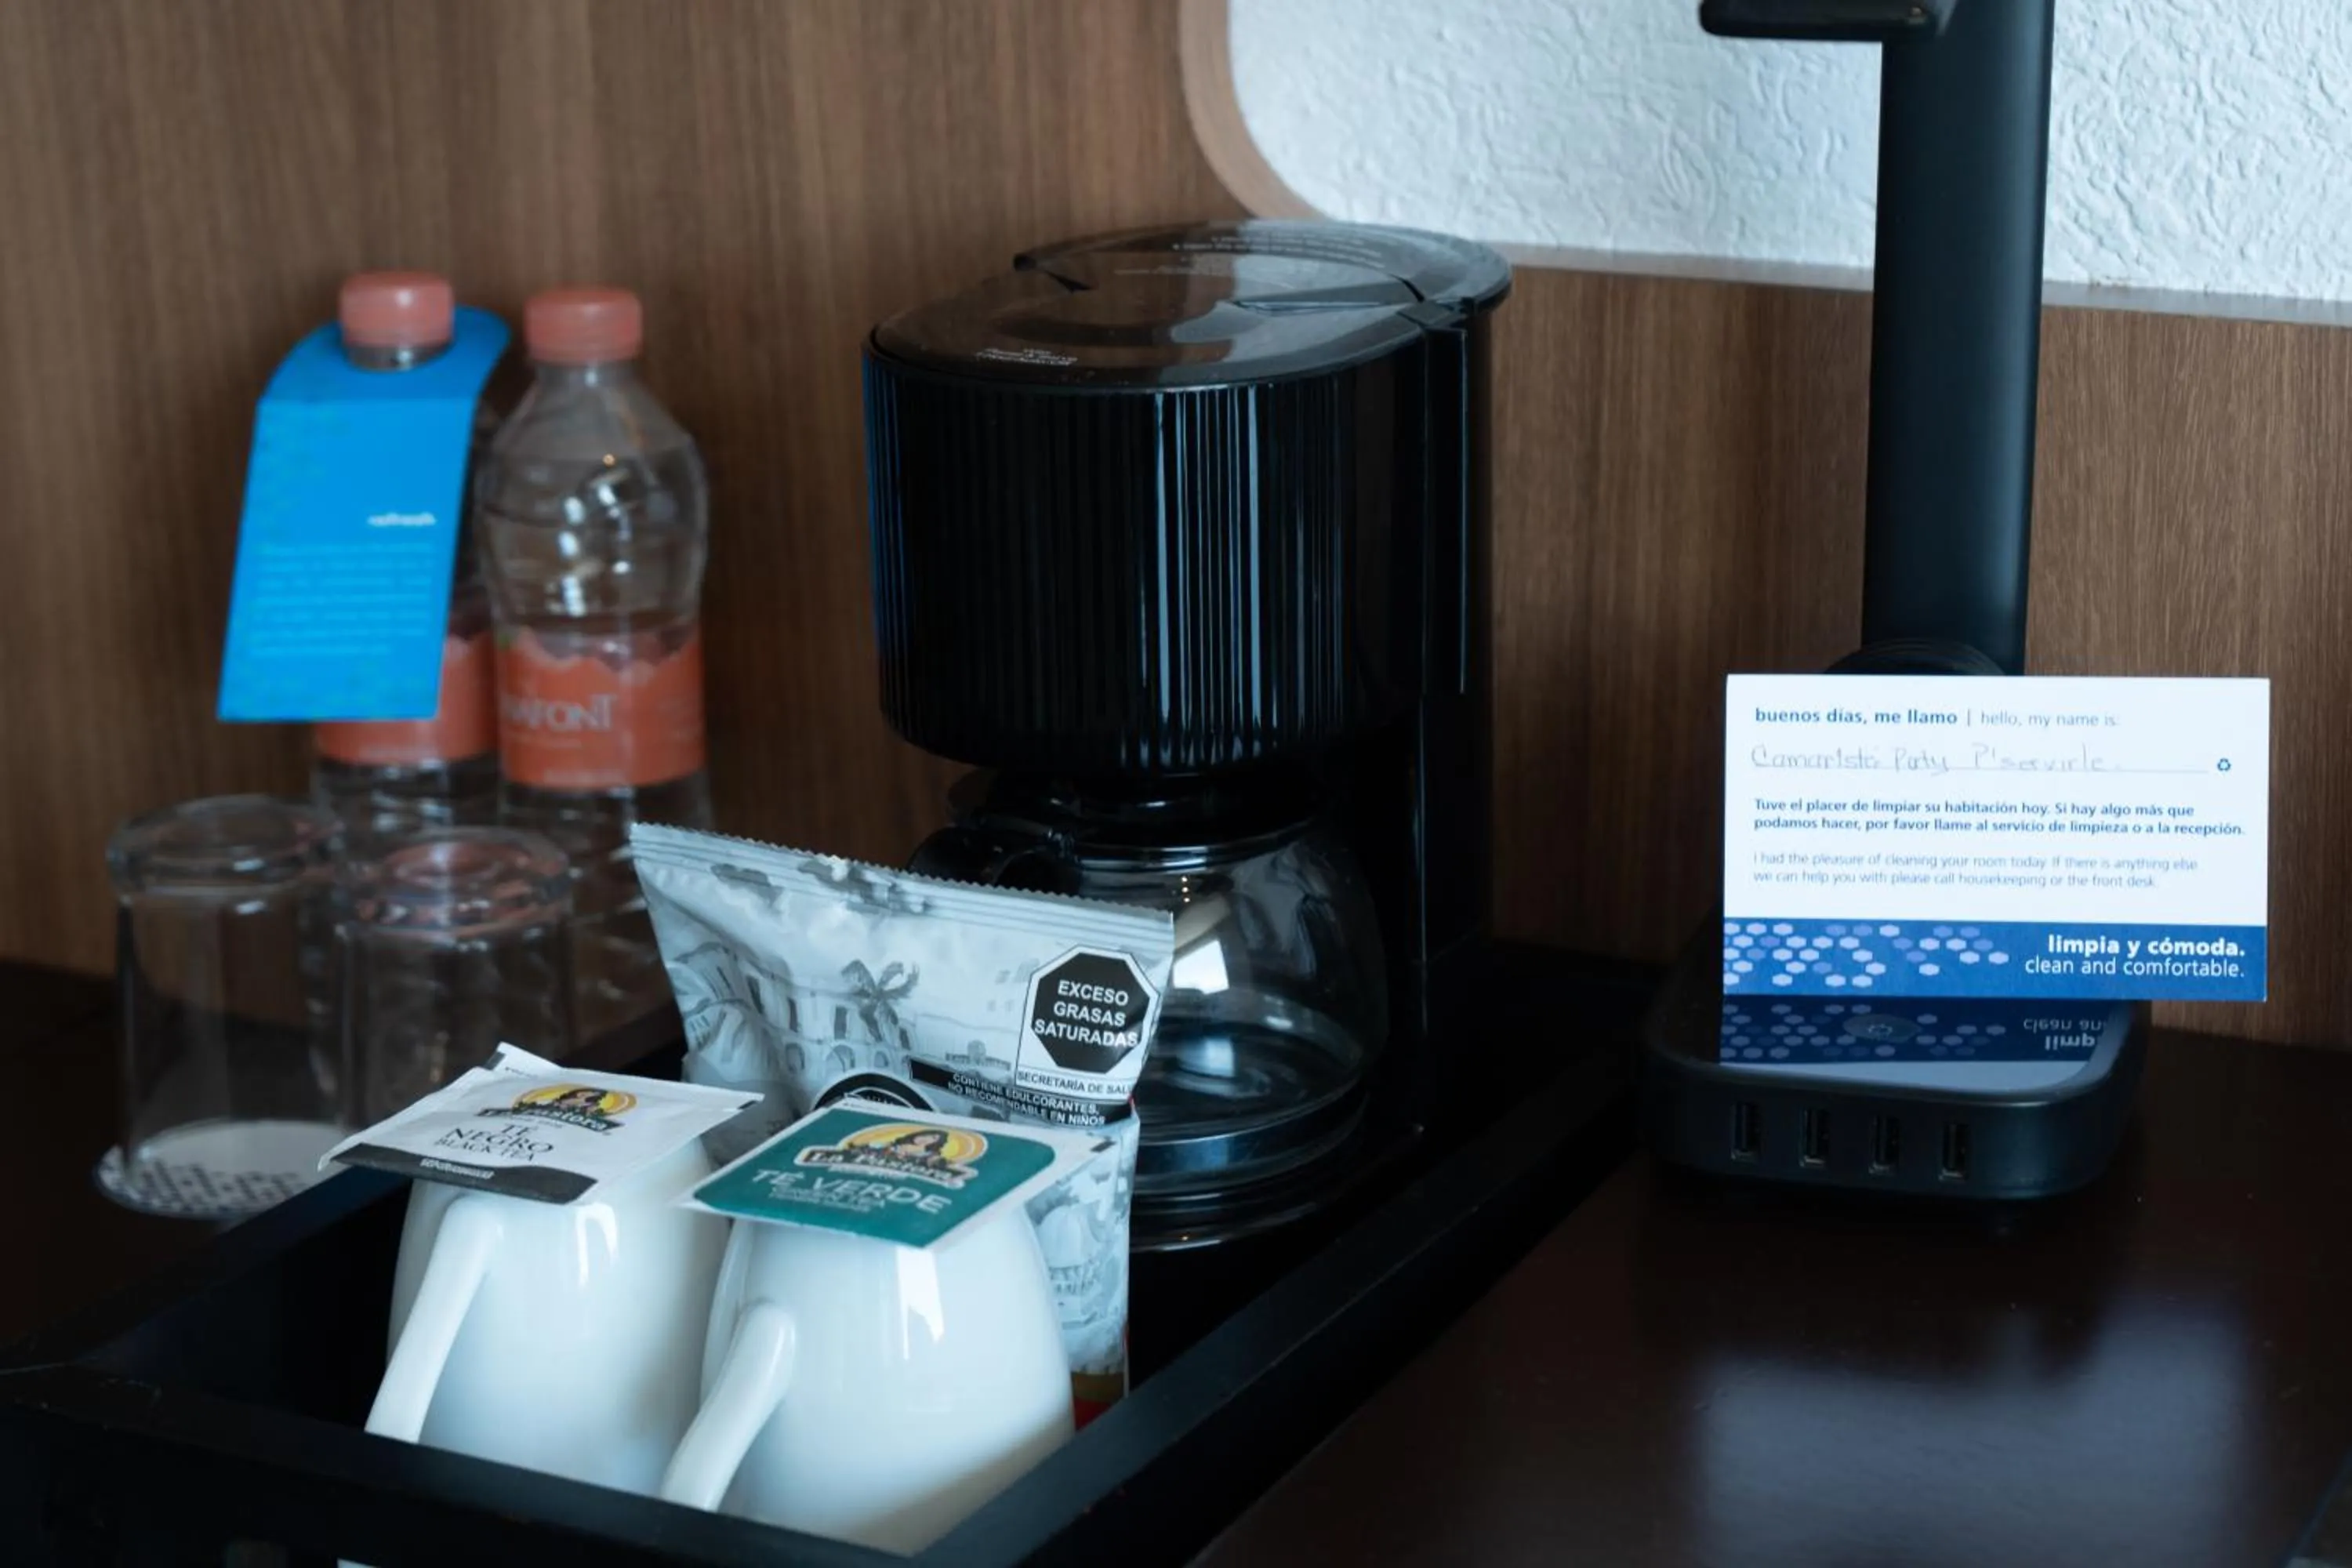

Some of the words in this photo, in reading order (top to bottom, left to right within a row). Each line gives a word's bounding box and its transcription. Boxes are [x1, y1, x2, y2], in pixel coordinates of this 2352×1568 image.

[1755, 708, 1820, 722] buenos
[1875, 711, 1900, 724] me
[1907, 709, 1958, 724] llamo
[1981, 710, 2023, 727] hello,
[2028, 713, 2050, 729] my
[2056, 714, 2099, 726] name
[1754, 799, 1786, 811] Tuve
[1790, 799, 1802, 811] el
[1806, 799, 1847, 814] placer
[1851, 800, 1868, 811] de
[1873, 800, 1920, 814] limpiar
[1925, 803, 1940, 813] su
[1945, 800, 2017, 815] habitación
[2055, 802, 2067, 814] Si
[2071, 803, 2096, 818] hay
[2100, 803, 2131, 818] algo
[2135, 803, 2164, 815] más
[2167, 807, 2194, 819] que
[1754, 817, 1817, 831] podamos
[1821, 818, 1861, 831] hacer,
[1865, 820, 1889, 833] por
[1893, 818, 1929, 830] favor
[1934, 818, 1972, 831] llame
[1976, 818, 1988, 831] al
[1992, 820, 2045, 833] servicio
[2049, 820, 2066, 833] de
[2070, 820, 2129, 836] limpieza
[2132, 823, 2142, 833] o
[2146, 823, 2154, 833] a
[2158, 821, 2170, 833] la
[1761, 853, 1784, 865] had
[1788, 853, 1808, 864] the
[1813, 852, 1864, 867] pleasure
[1867, 853, 1881, 865] of
[1885, 853, 1937, 869] cleaning
[1940, 856, 1969, 869] your
[1973, 857, 2006, 867] room
[2065, 856, 2098, 869] there
[2103, 857, 2111, 869] is
[2114, 857, 2170, 872] anything
[2172, 858, 2198, 870] else
[1754, 872, 1773, 881] we
[1776, 872, 1798, 882] can
[1802, 870, 1829, 884] help
[1832, 873, 1856, 885] you
[1860, 870, 1885, 883] with
[1891, 872, 1931, 886] please
[1933, 872, 1955, 884] call
[1959, 872, 2046, 887] housekeeping
[2050, 876, 2063, 886] or
[2067, 873, 2089, 886] the
[2092, 874, 2124, 887] front
[2048, 934, 2120, 957] limpia
[2126, 940, 2142, 958] y
[2147, 937, 2245, 956] cómoda.
[2025, 956, 2074, 974] clean
[2082, 956, 2116, 975] and
[2123, 957, 2245, 978] comfortable.
[1057, 979, 1130, 1006] EXCESO
[1053, 1000, 1127, 1028] GRASAS
[1033, 1018, 1138, 1048] SATURADAS
[953, 1073, 1004, 1094] CONTIENE
[1087, 1082, 1104, 1094] DE
[1050, 1109, 1065, 1123] EN
[445, 1127, 554, 1153] NEGRO
[812, 1176, 953, 1214] VERDE
